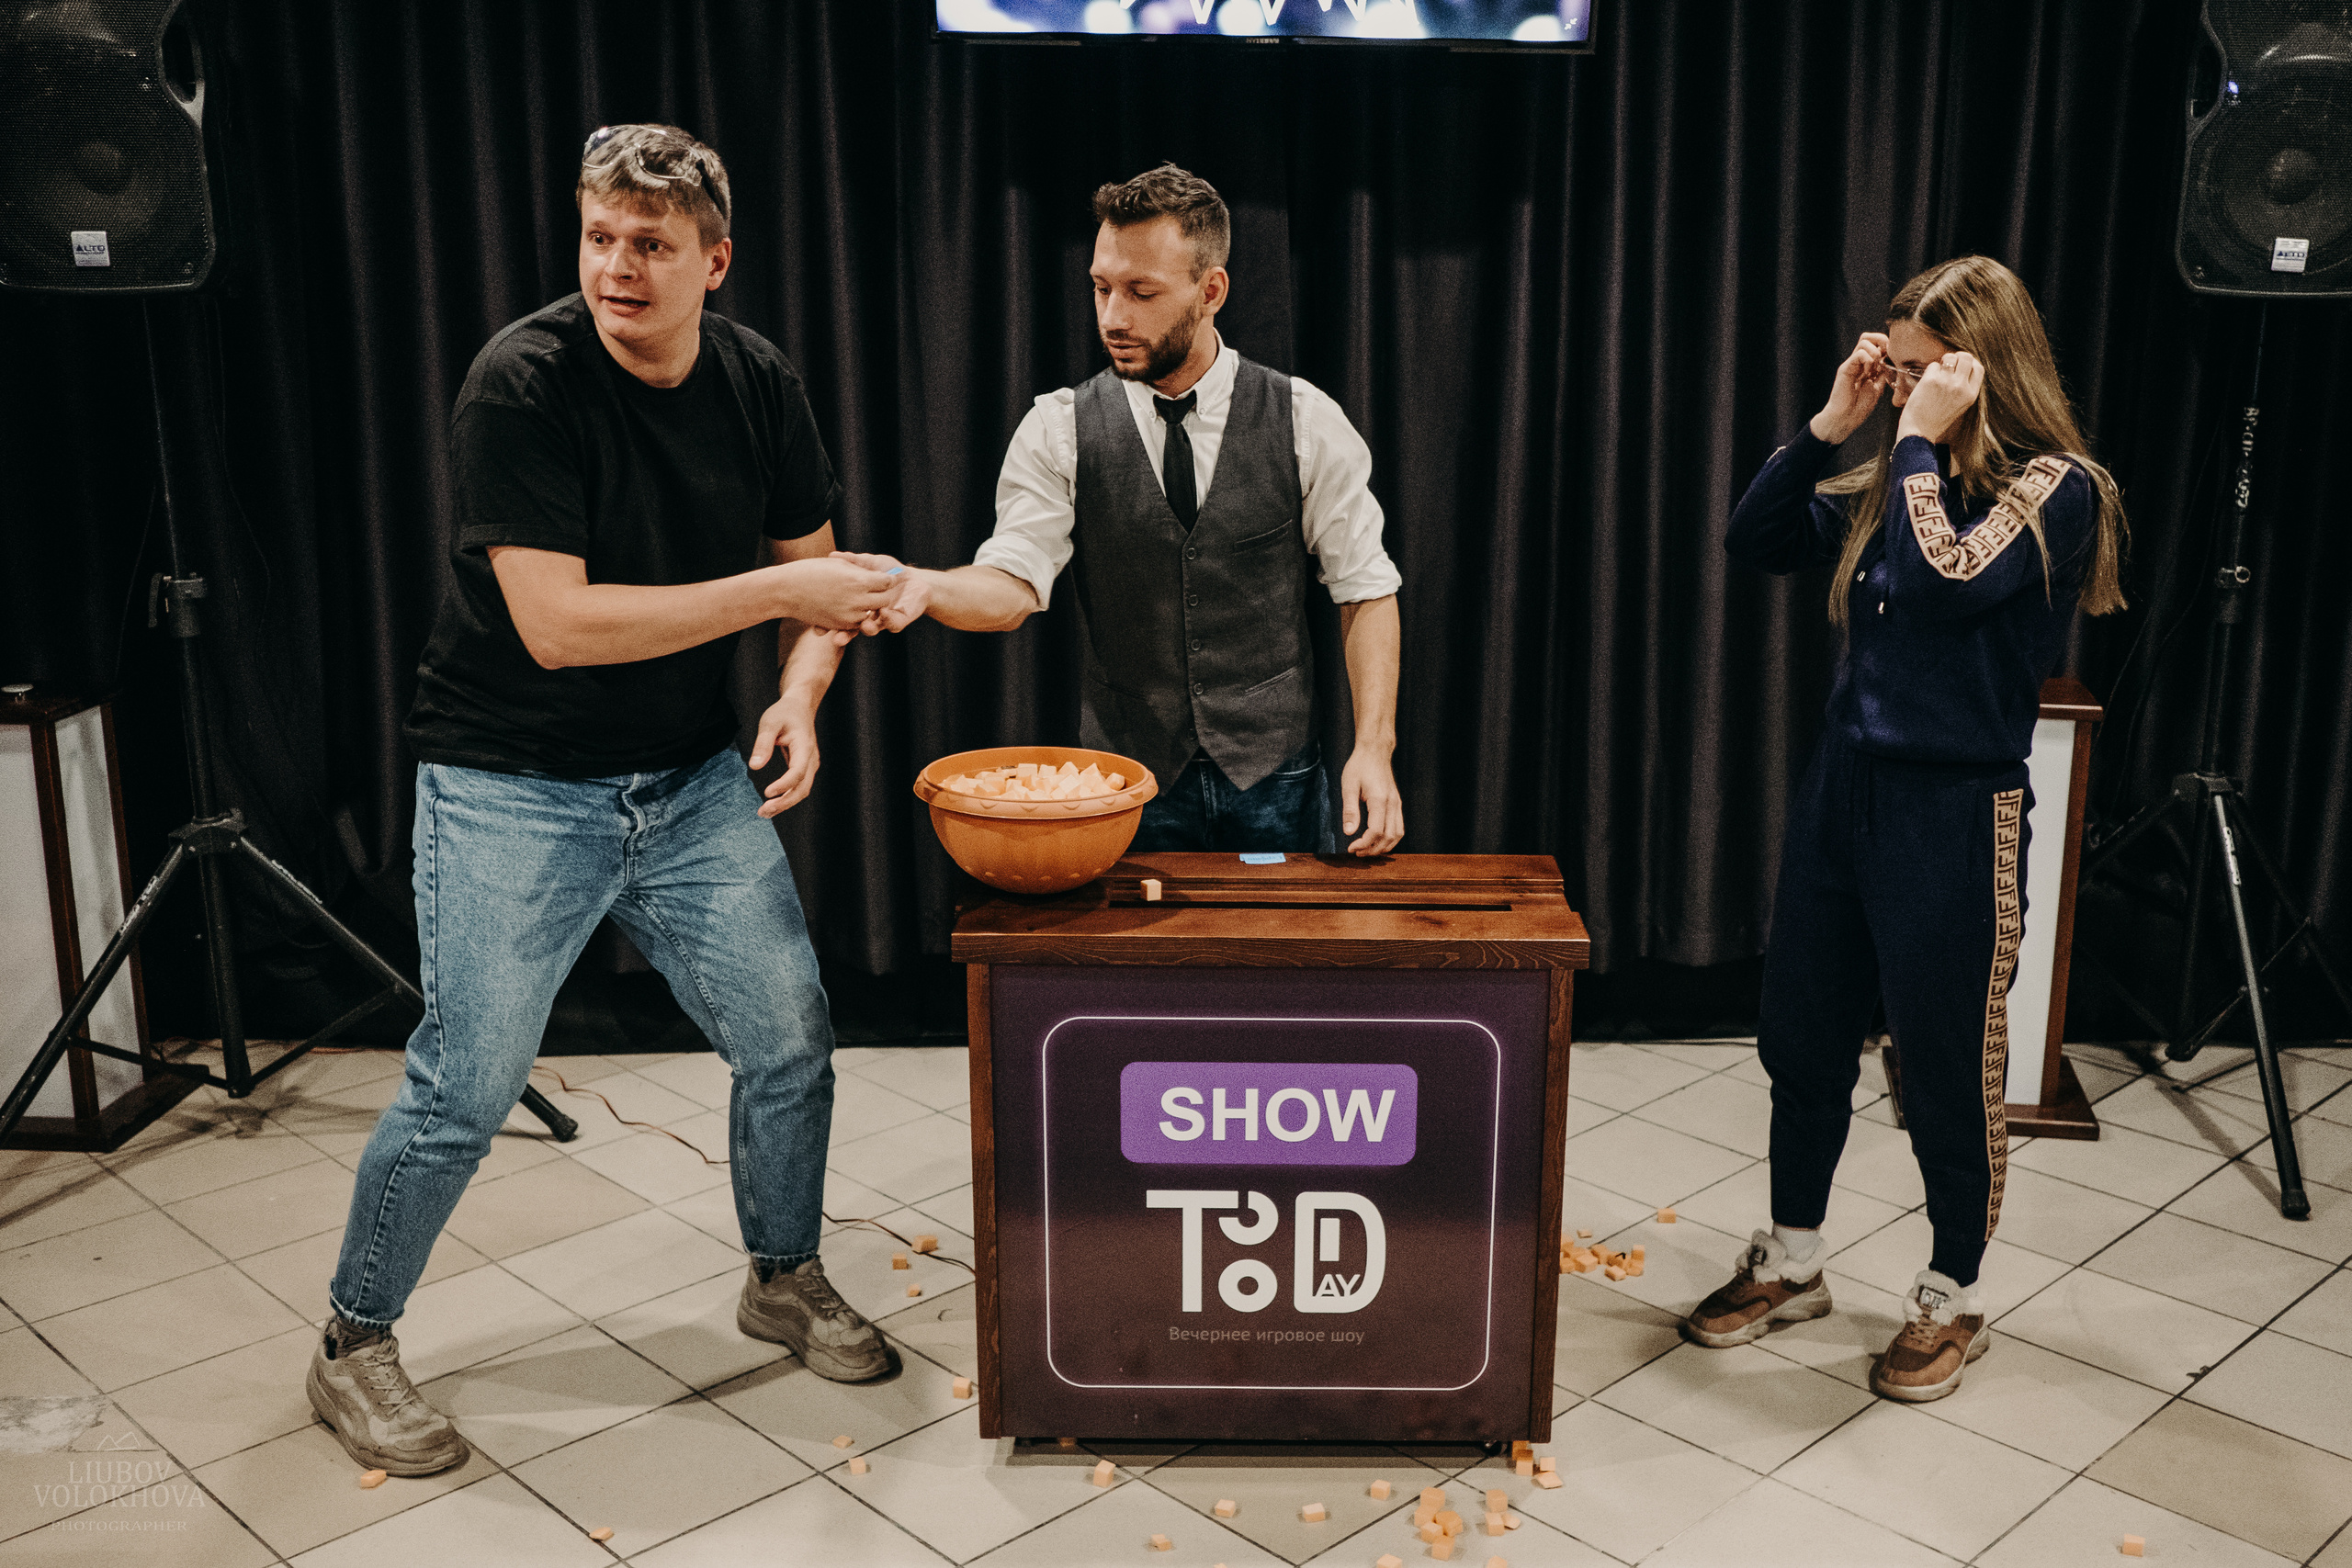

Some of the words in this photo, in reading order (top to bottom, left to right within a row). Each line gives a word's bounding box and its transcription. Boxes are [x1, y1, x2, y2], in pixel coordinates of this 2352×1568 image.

[1159, 1087, 1396, 1142] SHOW
[1169, 1326, 1250, 1344] Вечернее
[1257, 1331, 1325, 1344] игровое
[1331, 1332, 1365, 1345] шоу
